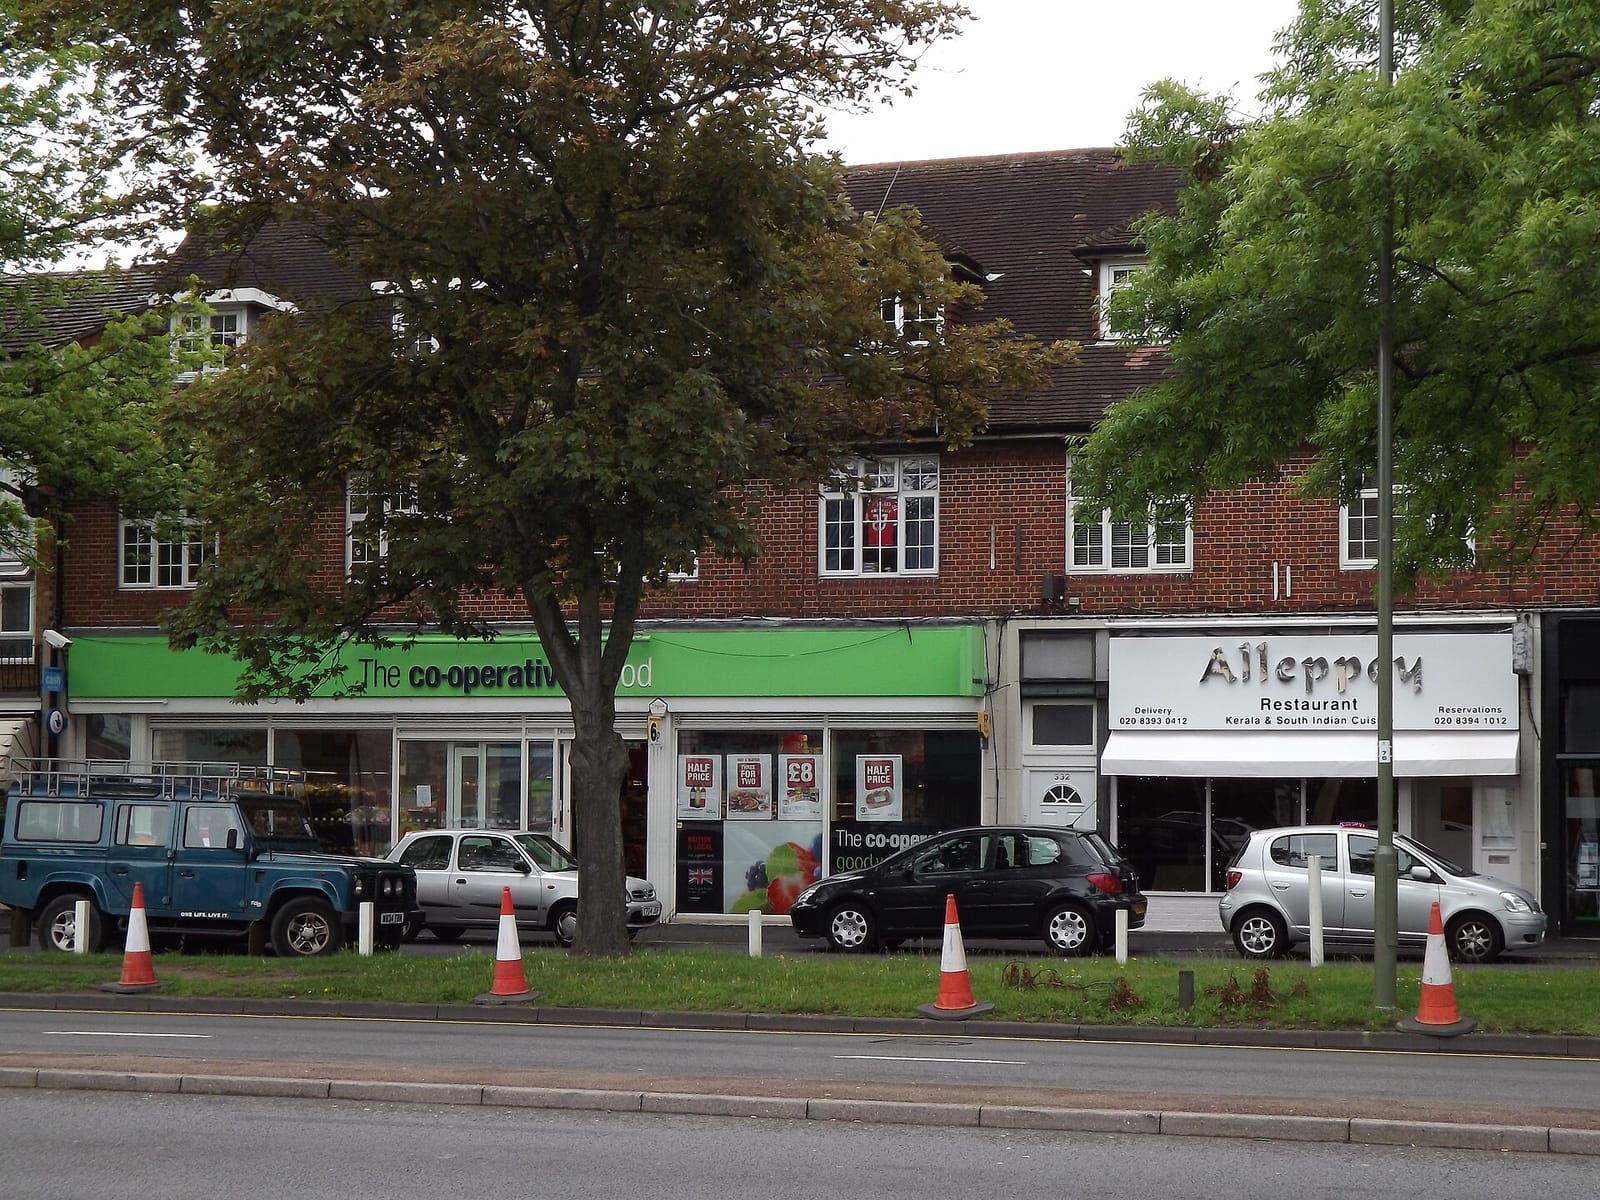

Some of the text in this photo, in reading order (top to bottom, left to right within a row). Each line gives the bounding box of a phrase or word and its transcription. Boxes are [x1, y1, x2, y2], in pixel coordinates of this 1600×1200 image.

[358, 657, 653, 693] The co-operativ od
[1260, 697, 1359, 711] Restaurant
[1134, 706, 1172, 716] Delivery
[1438, 706, 1503, 714] Reservations
[1119, 717, 1188, 725] 020 8393 0412
[1225, 716, 1383, 725] Kerala & South Indian Cuis
[1434, 717, 1507, 725] 020 8394 1012
[687, 763, 711, 773] HALF
[788, 762, 813, 782] £8
[866, 765, 891, 775] HALF
[687, 773, 711, 782] PRICE
[740, 769, 756, 778] FOR
[741, 777, 756, 785] TWO
[866, 775, 891, 784] PRICE
[835, 829, 862, 848] The
[836, 852, 873, 873] good
